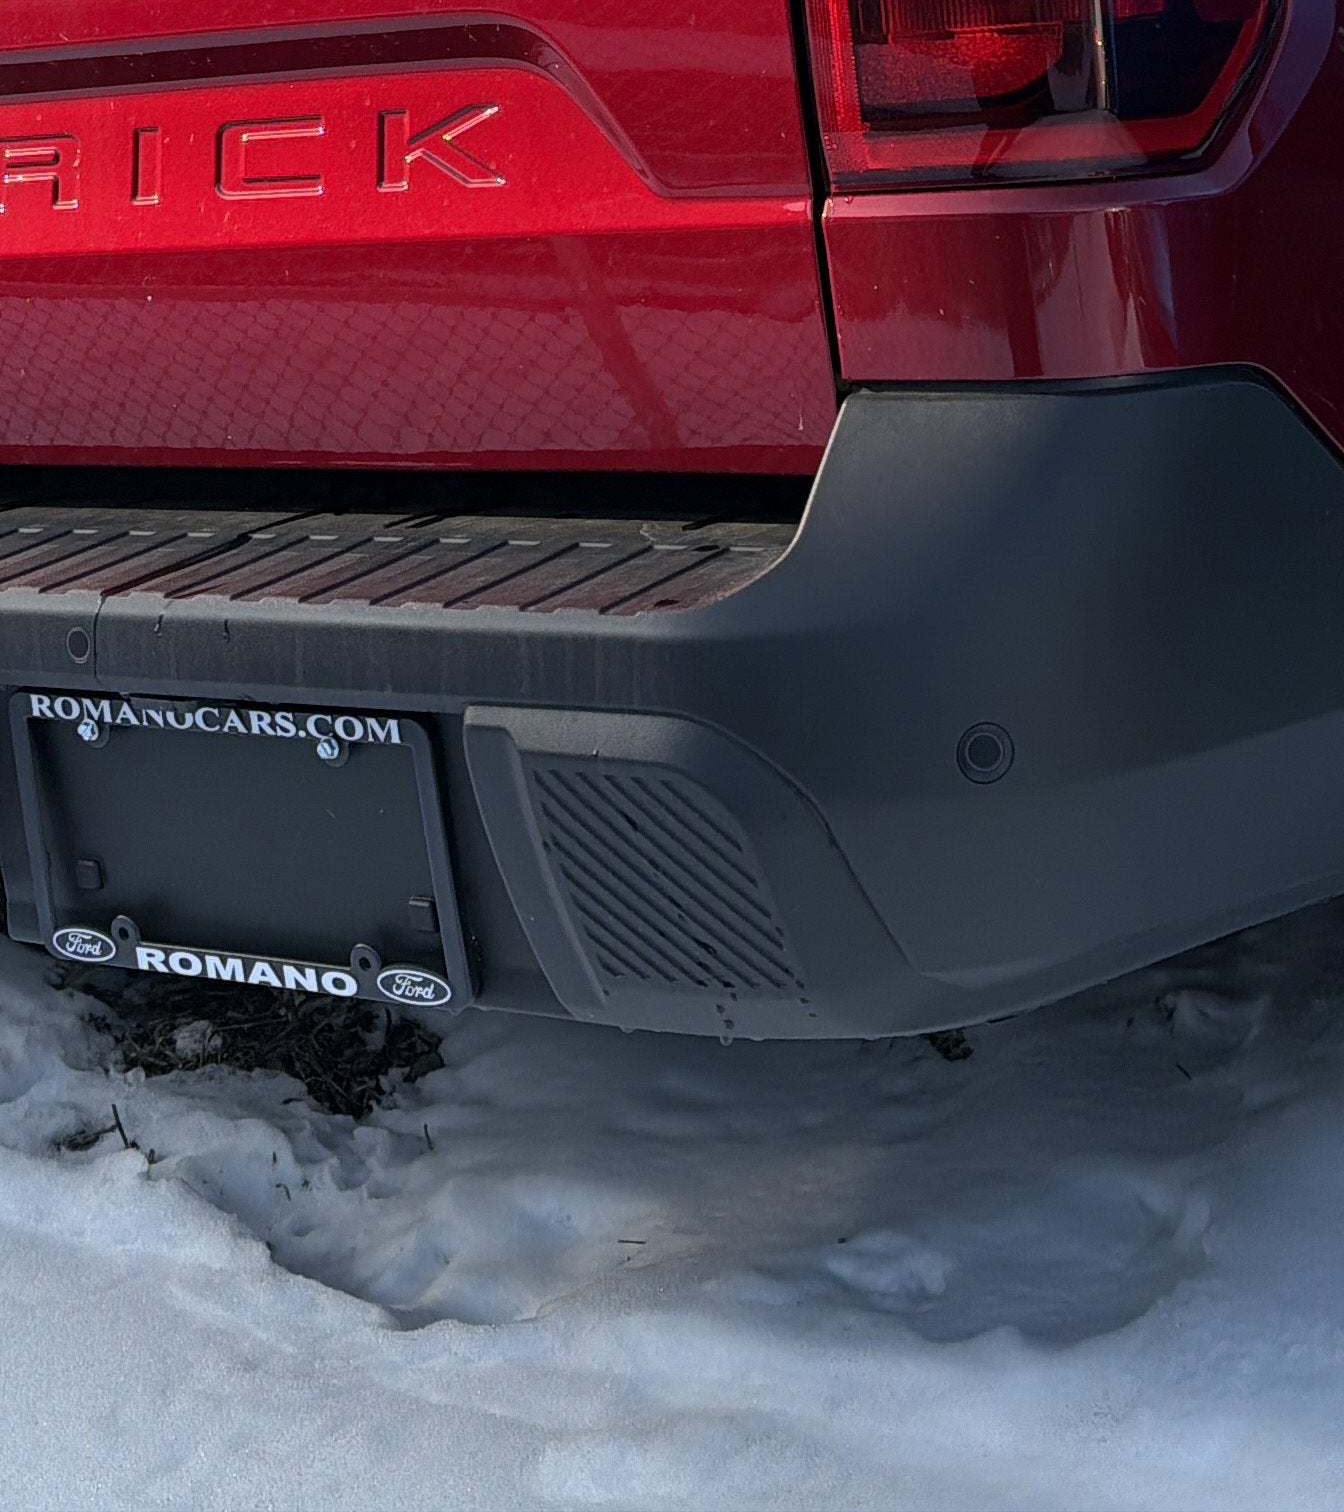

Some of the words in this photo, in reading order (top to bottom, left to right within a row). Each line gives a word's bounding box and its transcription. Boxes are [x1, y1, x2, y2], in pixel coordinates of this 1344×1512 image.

[29, 692, 402, 744] ROMANOCARS.COM
[64, 931, 103, 957] Ford
[135, 945, 358, 998] ROMANO
[391, 973, 437, 1001] Ford
